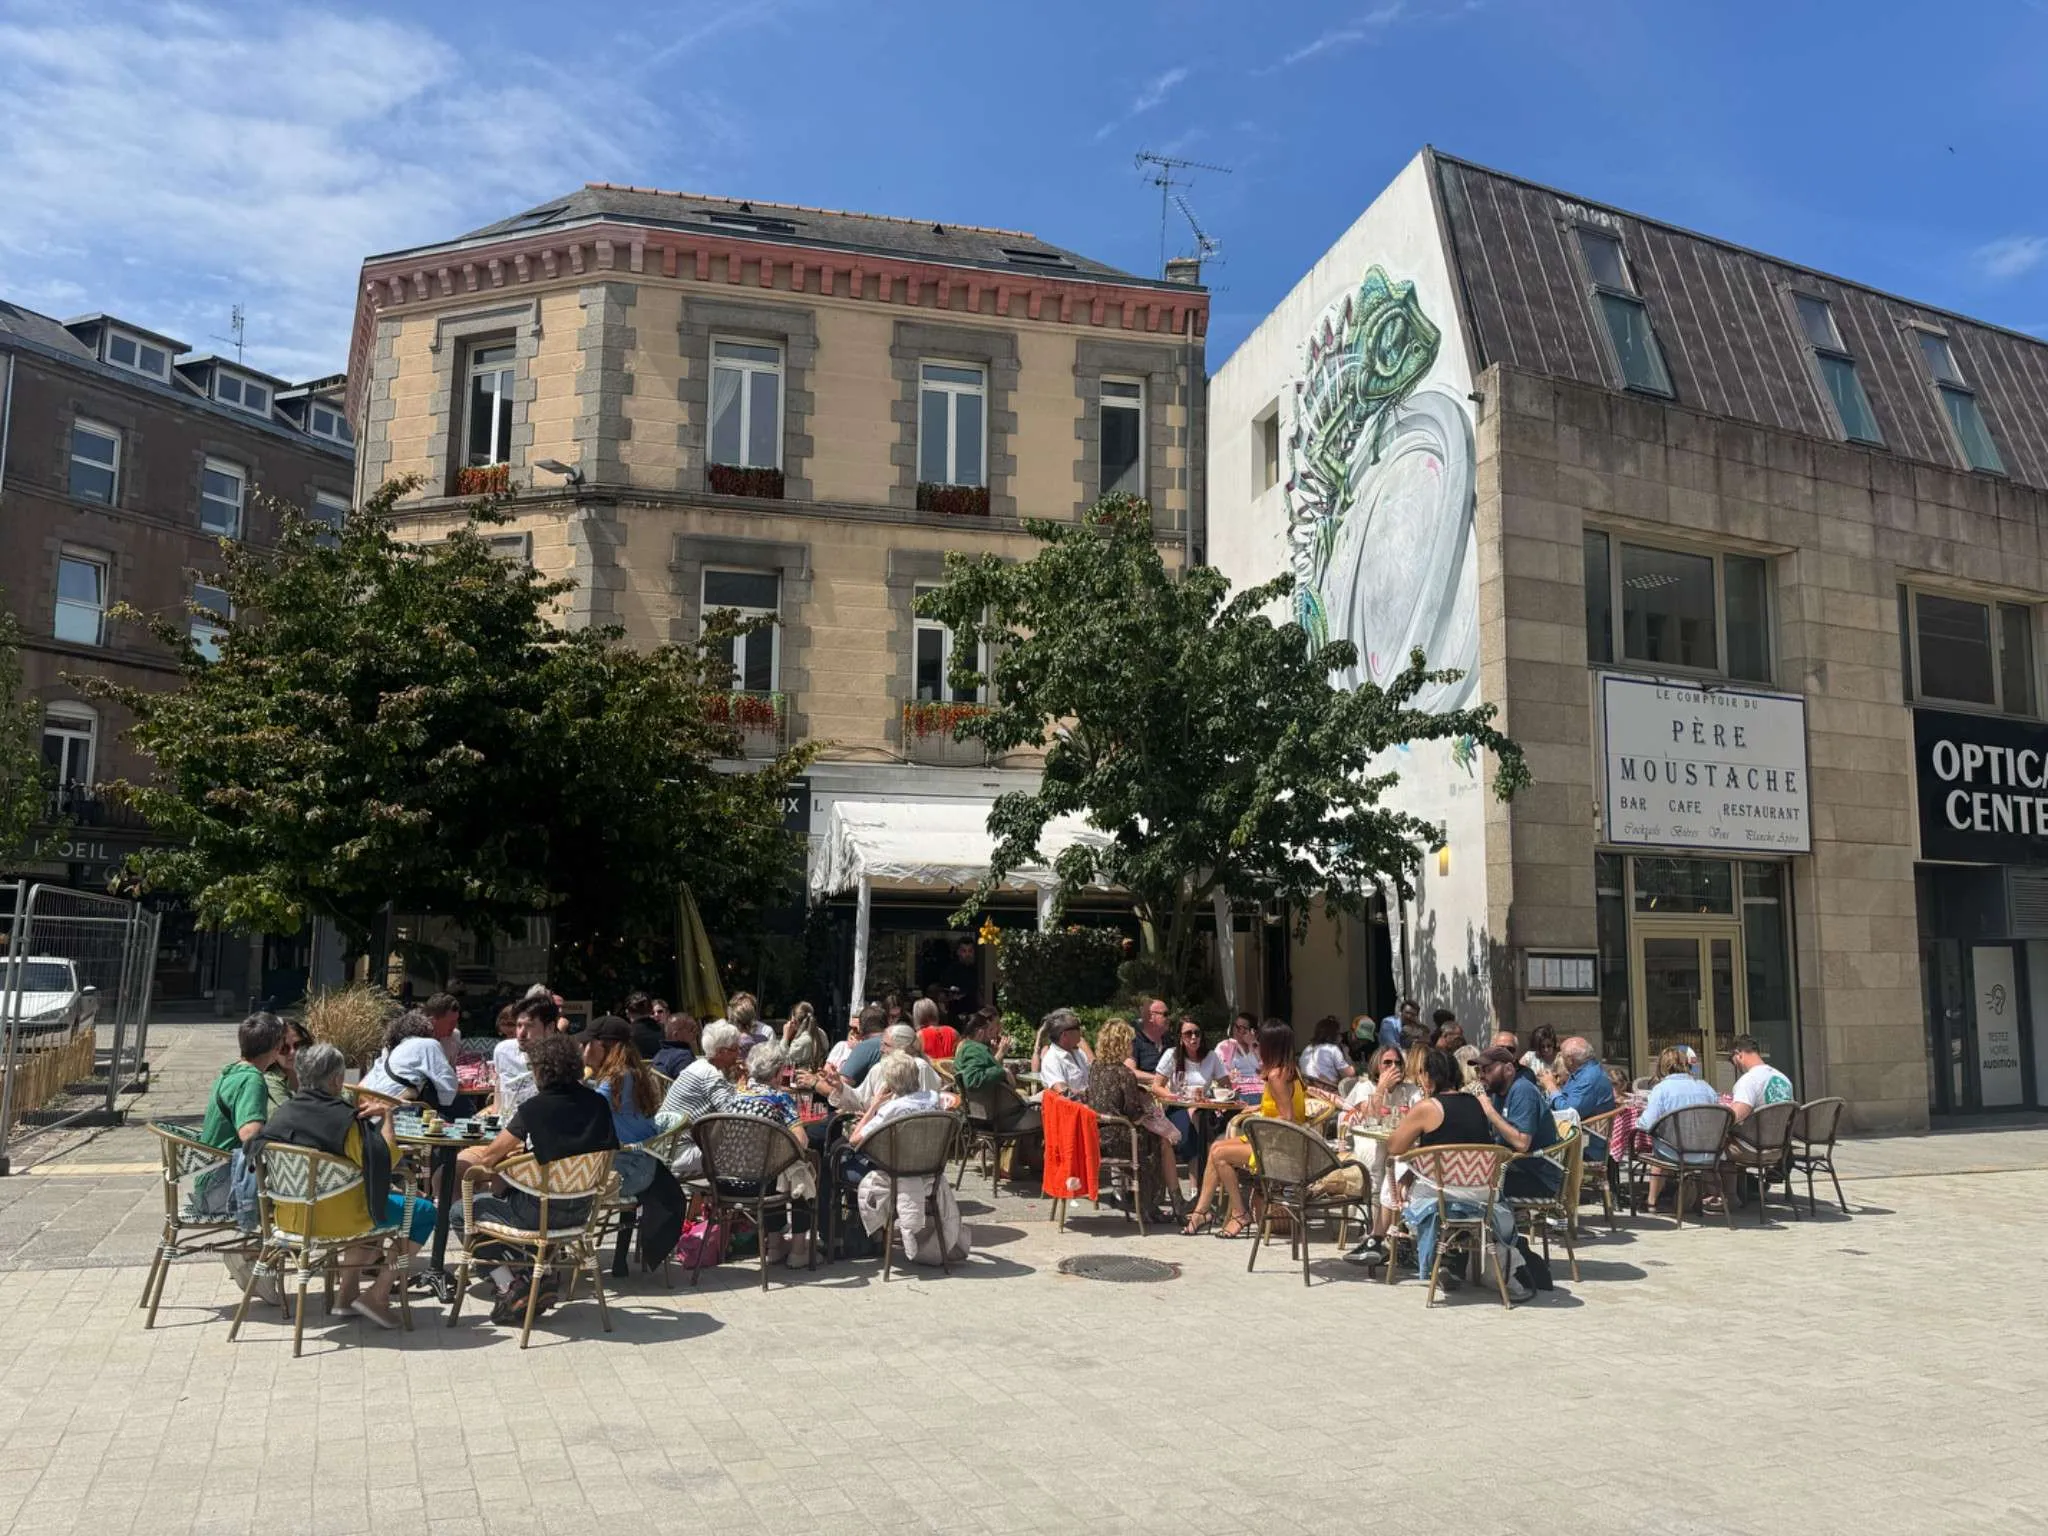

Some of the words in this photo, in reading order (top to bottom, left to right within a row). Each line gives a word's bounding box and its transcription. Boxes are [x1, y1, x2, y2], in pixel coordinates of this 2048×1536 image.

[1656, 689, 1670, 700] LE
[1677, 692, 1738, 708] COMPTOIR
[1744, 699, 1758, 710] DU
[1672, 715, 1748, 749] PÈRE
[1620, 757, 1798, 794] MOUSTACHE
[1620, 796, 1647, 811] BAR
[1723, 803, 1800, 821] RESTAURANT
[1983, 1059, 2018, 1069] AUDITION
